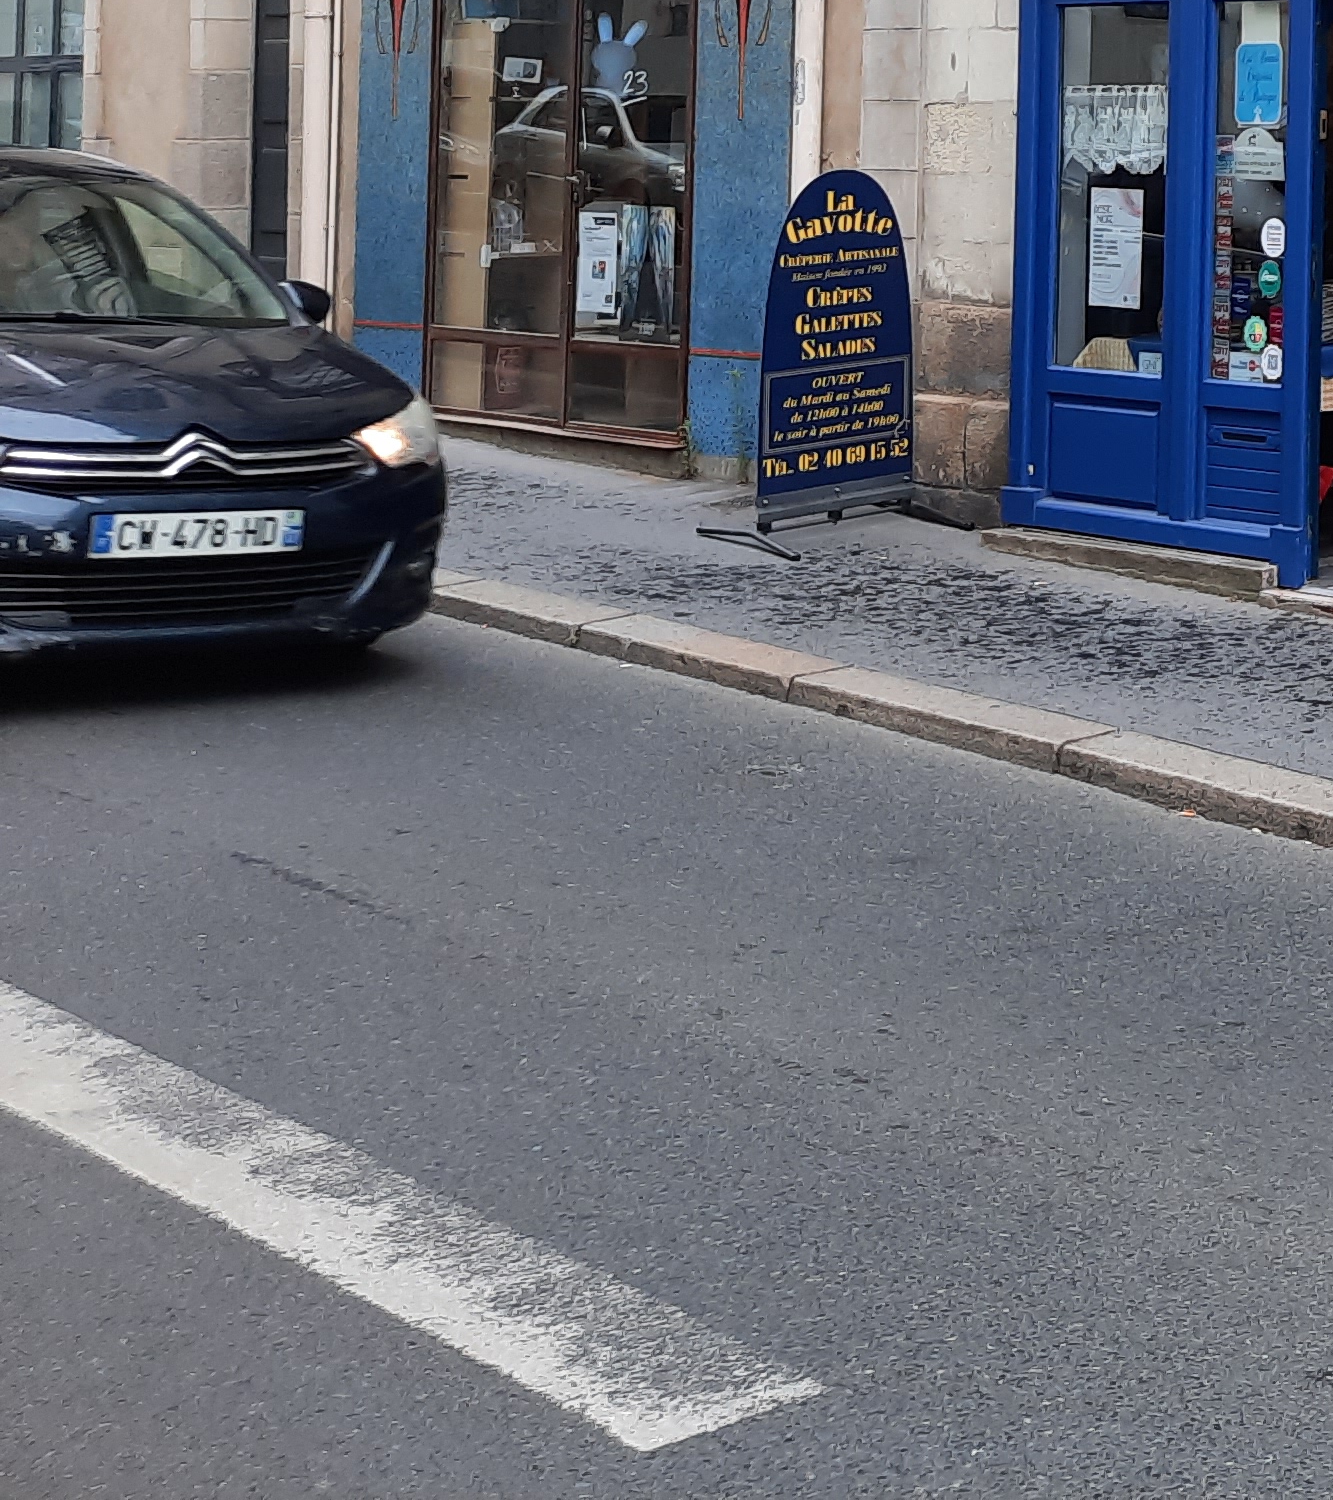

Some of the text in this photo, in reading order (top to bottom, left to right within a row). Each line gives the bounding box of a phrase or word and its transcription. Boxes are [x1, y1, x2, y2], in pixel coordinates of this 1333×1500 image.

[623, 70, 648, 96] 23
[826, 190, 855, 213] La
[786, 207, 893, 244] Gavotte
[812, 372, 864, 388] OUVERT
[783, 397, 798, 408] du
[800, 391, 834, 406] Mardi
[852, 383, 892, 399] Samedi
[790, 412, 803, 423] de
[819, 421, 850, 438] partir
[798, 452, 819, 472] 02
[823, 448, 842, 468] 40
[846, 445, 866, 464] 69
[870, 442, 886, 460] 15
[890, 438, 909, 457] 52
